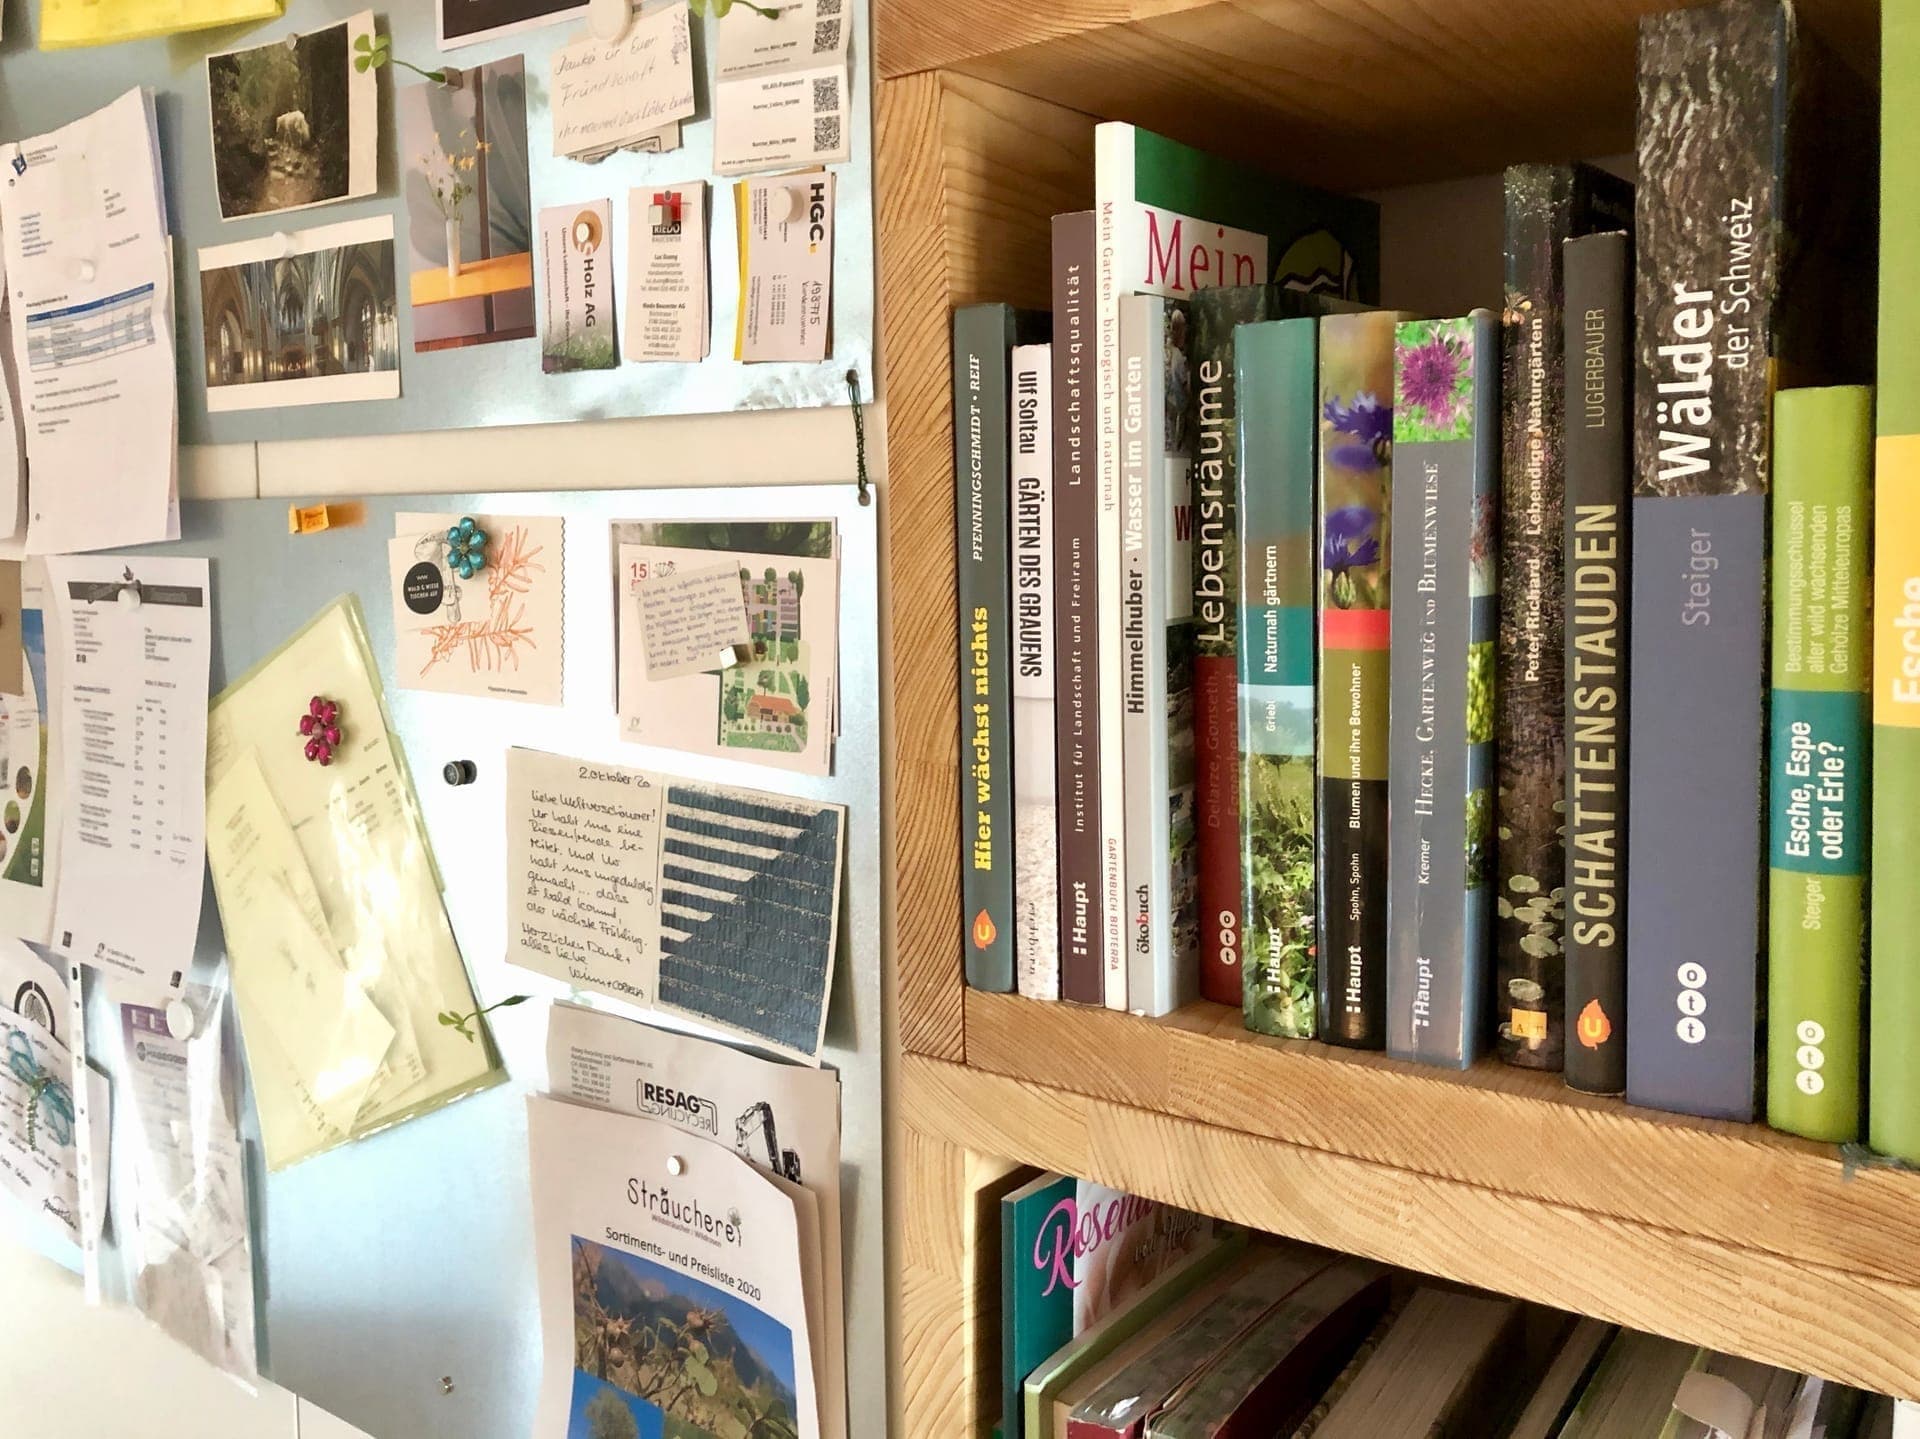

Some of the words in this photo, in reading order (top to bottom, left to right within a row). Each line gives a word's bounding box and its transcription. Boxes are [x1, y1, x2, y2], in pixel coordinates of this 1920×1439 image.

[810, 183, 825, 242] HGC
[1102, 202, 1114, 241] Mein
[583, 258, 596, 299] Holz
[1102, 247, 1114, 301] Garten
[1144, 210, 1255, 291] Mein
[1720, 197, 1753, 315] Schweiz
[585, 302, 596, 328] AG
[969, 354, 980, 391] REIF
[1066, 264, 1083, 485] Landschaftsqualität
[1100, 318, 1115, 399] biologisch
[1526, 318, 1546, 433] Naturgärten
[1584, 309, 1605, 428] LUGERBAUER
[1718, 324, 1750, 369] der
[1018, 371, 1038, 394] Ulf
[1124, 356, 1142, 433] Garten
[1656, 280, 1714, 481] Wälder
[1018, 398, 1037, 454] Soltau
[1101, 406, 1114, 434] und
[970, 405, 983, 562] PFENNINGSCHMIDT
[1100, 440, 1115, 512] naturnah
[1125, 440, 1142, 467] im
[1018, 478, 1045, 548] GÄRTEN
[1125, 475, 1143, 551] Wasser
[1194, 360, 1225, 641] Lebensräume
[1525, 439, 1546, 536] Lebendige
[631, 562, 648, 578] 15
[1019, 554, 1040, 588] DES
[1070, 537, 1081, 607] Freiraum
[1264, 545, 1281, 605] gärtnern
[1681, 527, 1719, 626] Steiger
[1808, 504, 1828, 601] wachsenden
[1831, 505, 1856, 610] Mitteleuropas
[1525, 558, 1541, 630] Richard
[1807, 605, 1826, 636] wild
[970, 607, 990, 695] nichts
[1020, 593, 1042, 677] GRAUENS
[1071, 615, 1082, 643] und
[1125, 570, 1145, 714] Himmelhuber
[1264, 610, 1278, 673] Naturnah
[1525, 634, 1541, 682] Peter
[1806, 640, 1825, 673] aller
[1071, 651, 1083, 736] Landschaft
[1265, 700, 1277, 732] Griebl
[1349, 663, 1361, 725] Bewohner
[971, 703, 991, 803] wächst
[1073, 743, 1084, 765] für
[1349, 728, 1361, 753] ihre
[1573, 504, 1617, 947] SCHATTENSTAUDEN
[1787, 721, 1821, 777] Espe
[1349, 756, 1361, 779] und
[1817, 741, 1845, 802] Erle?
[1073, 773, 1085, 832] Institut
[1349, 782, 1361, 829] Blumen
[1785, 783, 1816, 858] Esche,
[974, 811, 993, 871] Hier
[1418, 838, 1431, 884] Kremer
[1818, 807, 1845, 860] oder
[1108, 838, 1118, 912] GARTENBUCH
[1349, 853, 1362, 884] Spohn
[1135, 884, 1150, 954] ökobuch
[1349, 887, 1361, 921] Spohn,
[1802, 877, 1826, 931] Steiger
[1109, 916, 1118, 970] BIOTERRA
[644, 1082, 701, 1114] RESAG
[606, 1226, 666, 1257] Sortiments-
[668, 1250, 688, 1267] und
[690, 1257, 735, 1288] Preisliste
[737, 1278, 761, 1301] 2020
